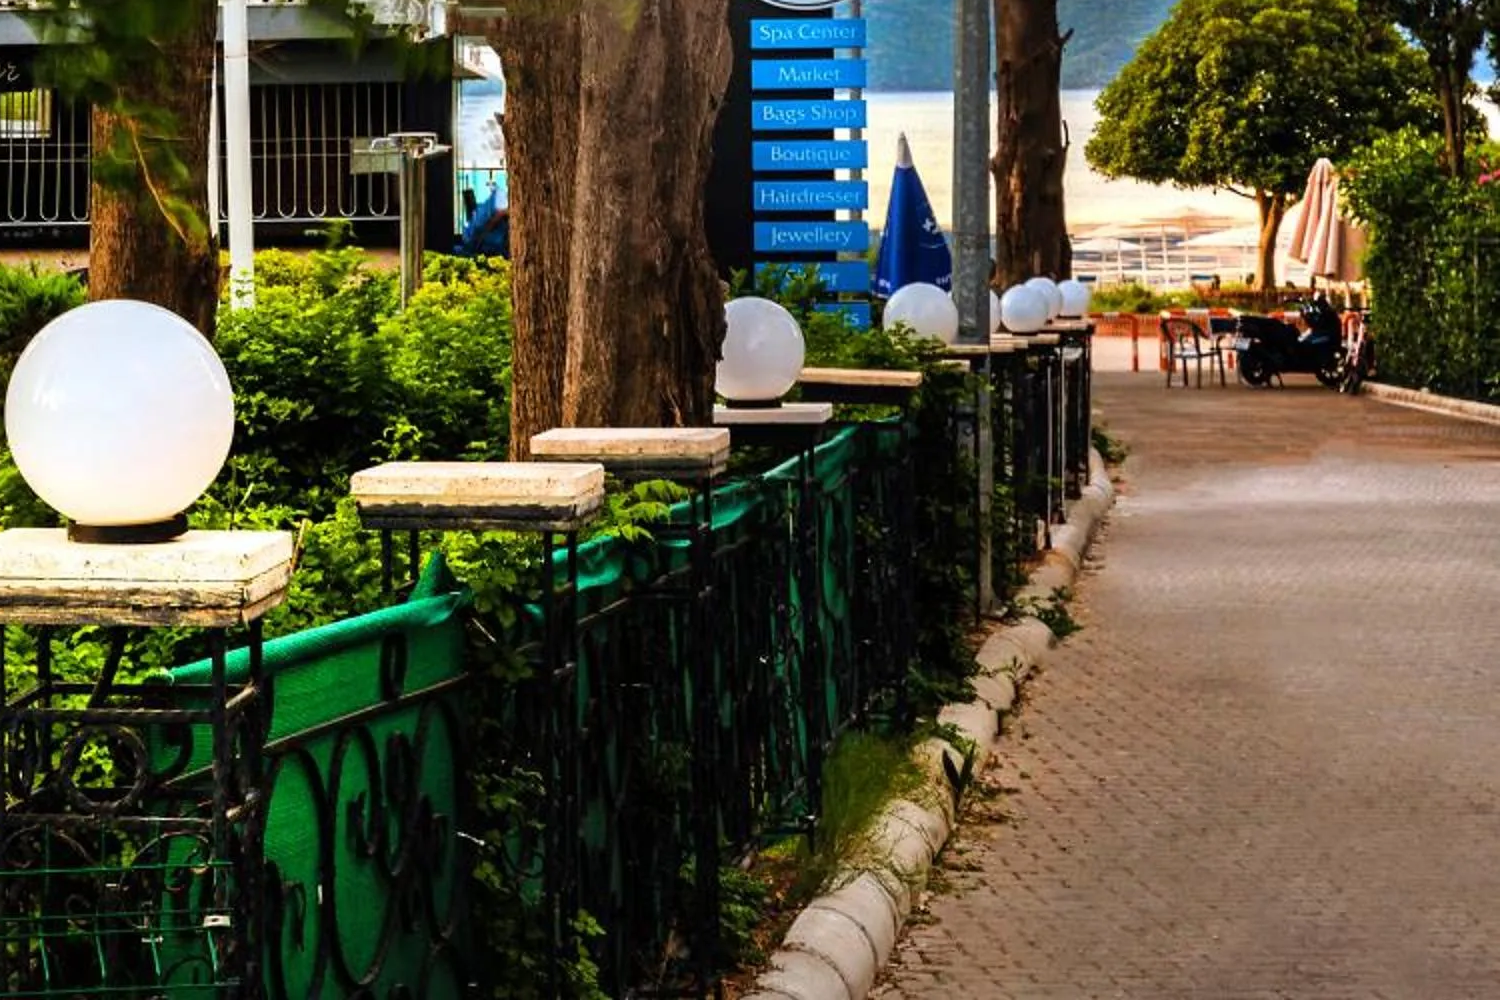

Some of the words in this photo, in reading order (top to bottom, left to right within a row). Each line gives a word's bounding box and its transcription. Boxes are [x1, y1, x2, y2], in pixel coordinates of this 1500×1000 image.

[760, 23, 793, 43] Spa
[796, 23, 857, 39] Center
[779, 67, 841, 82] Market
[763, 106, 805, 124] Bags
[811, 105, 857, 123] Shop
[771, 146, 851, 164] Boutique
[761, 188, 862, 204] Hairdresser
[771, 226, 852, 246] Jewellery
